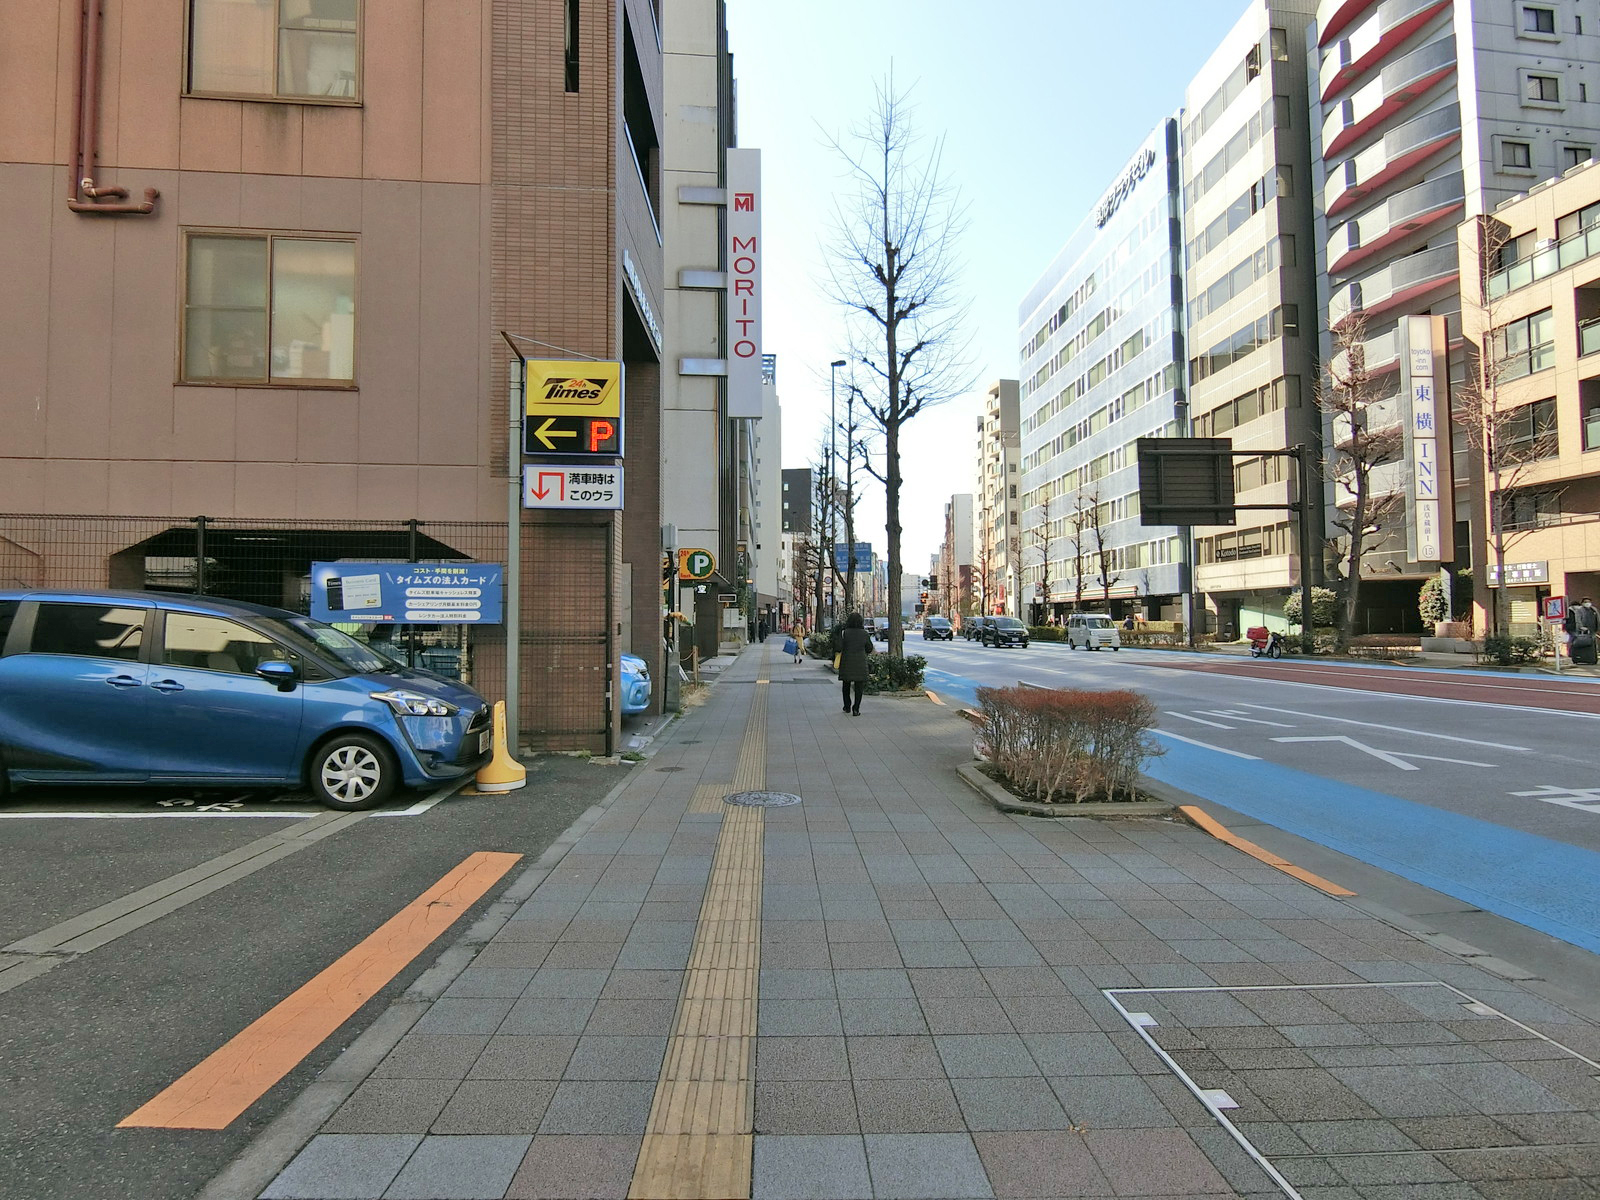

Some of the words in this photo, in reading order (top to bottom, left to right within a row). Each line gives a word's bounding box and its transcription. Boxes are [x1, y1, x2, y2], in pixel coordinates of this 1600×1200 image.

[733, 236, 757, 359] MORITO
[545, 384, 601, 399] Times
[590, 421, 614, 452] P
[568, 472, 615, 485] 満車時は
[570, 490, 614, 501] このウラ
[694, 555, 709, 574] P
[396, 575, 486, 585] タイムズの法人カード
